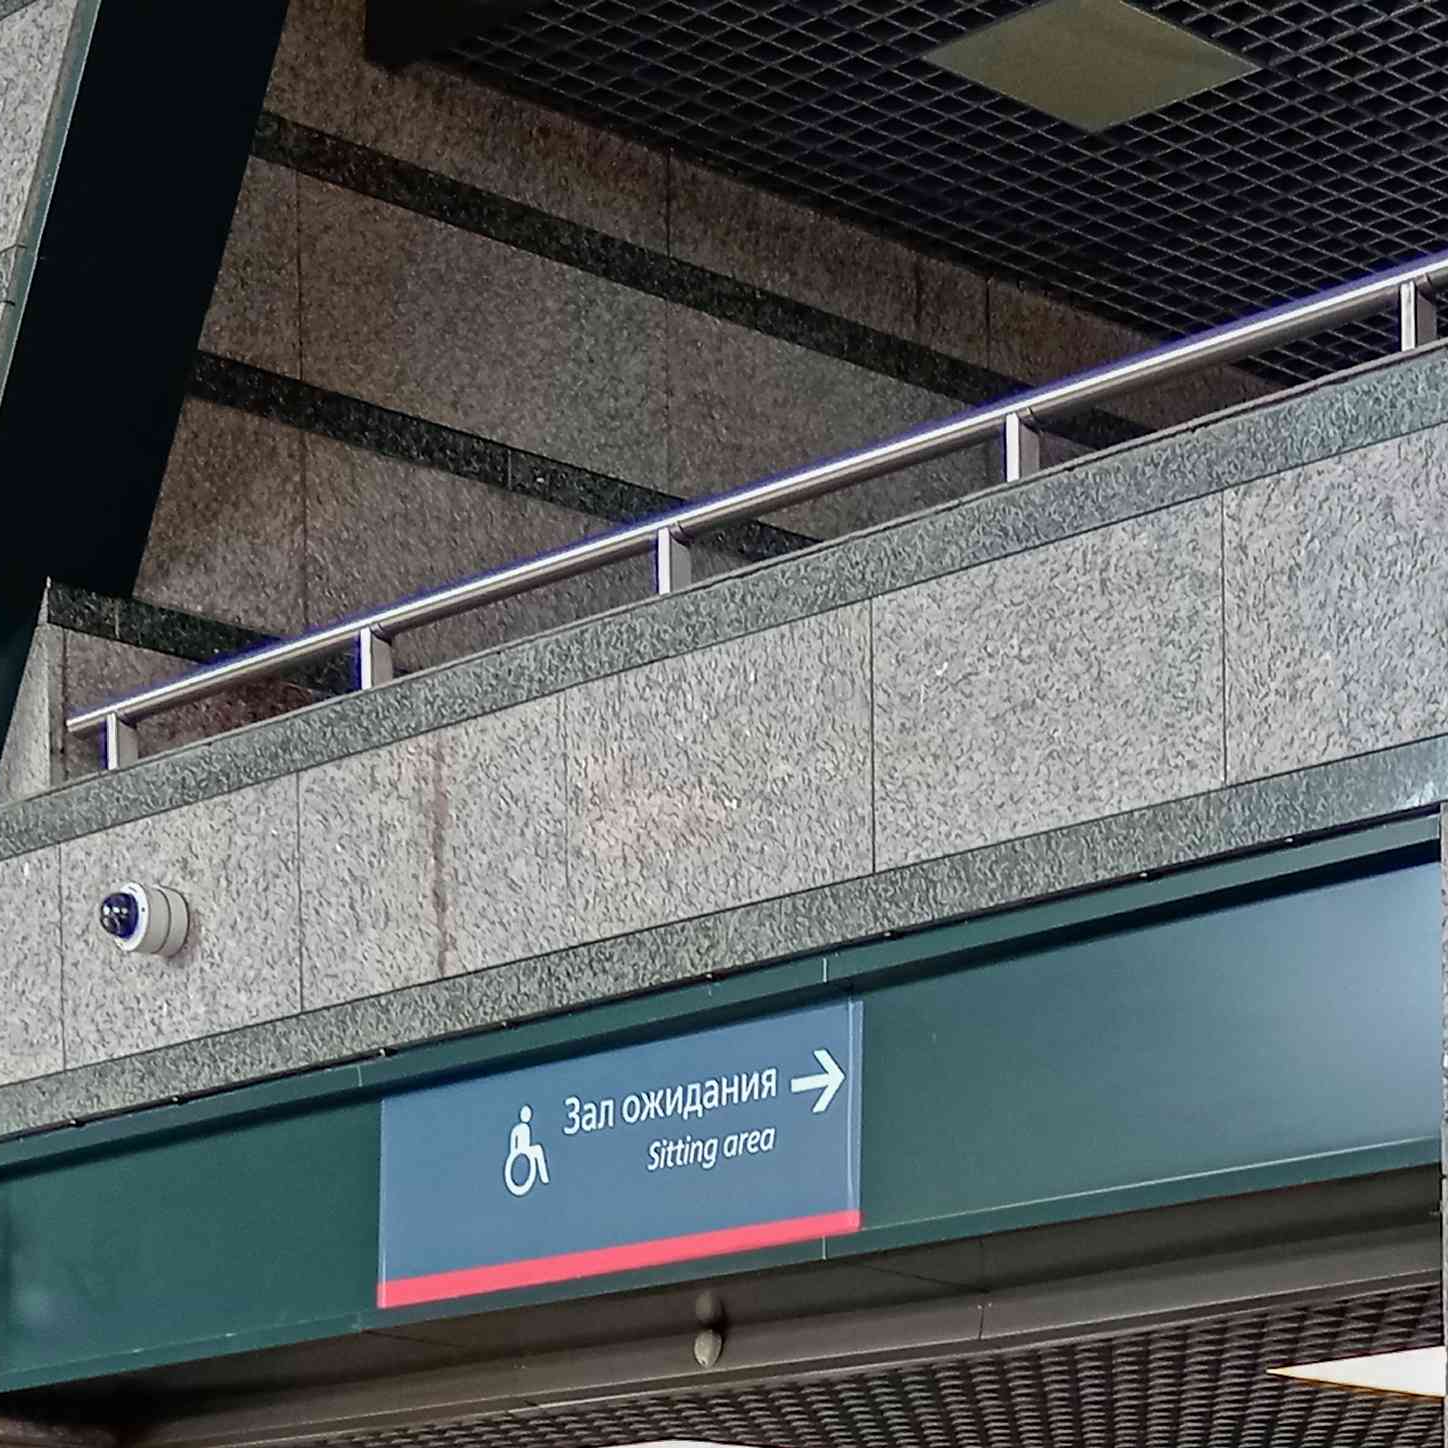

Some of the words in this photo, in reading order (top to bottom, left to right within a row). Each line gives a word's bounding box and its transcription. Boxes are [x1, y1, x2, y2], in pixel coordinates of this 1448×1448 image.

[563, 1097, 614, 1135] Зал
[622, 1067, 778, 1122] ожидания
[648, 1135, 718, 1170] Sitting
[723, 1126, 775, 1158] area
